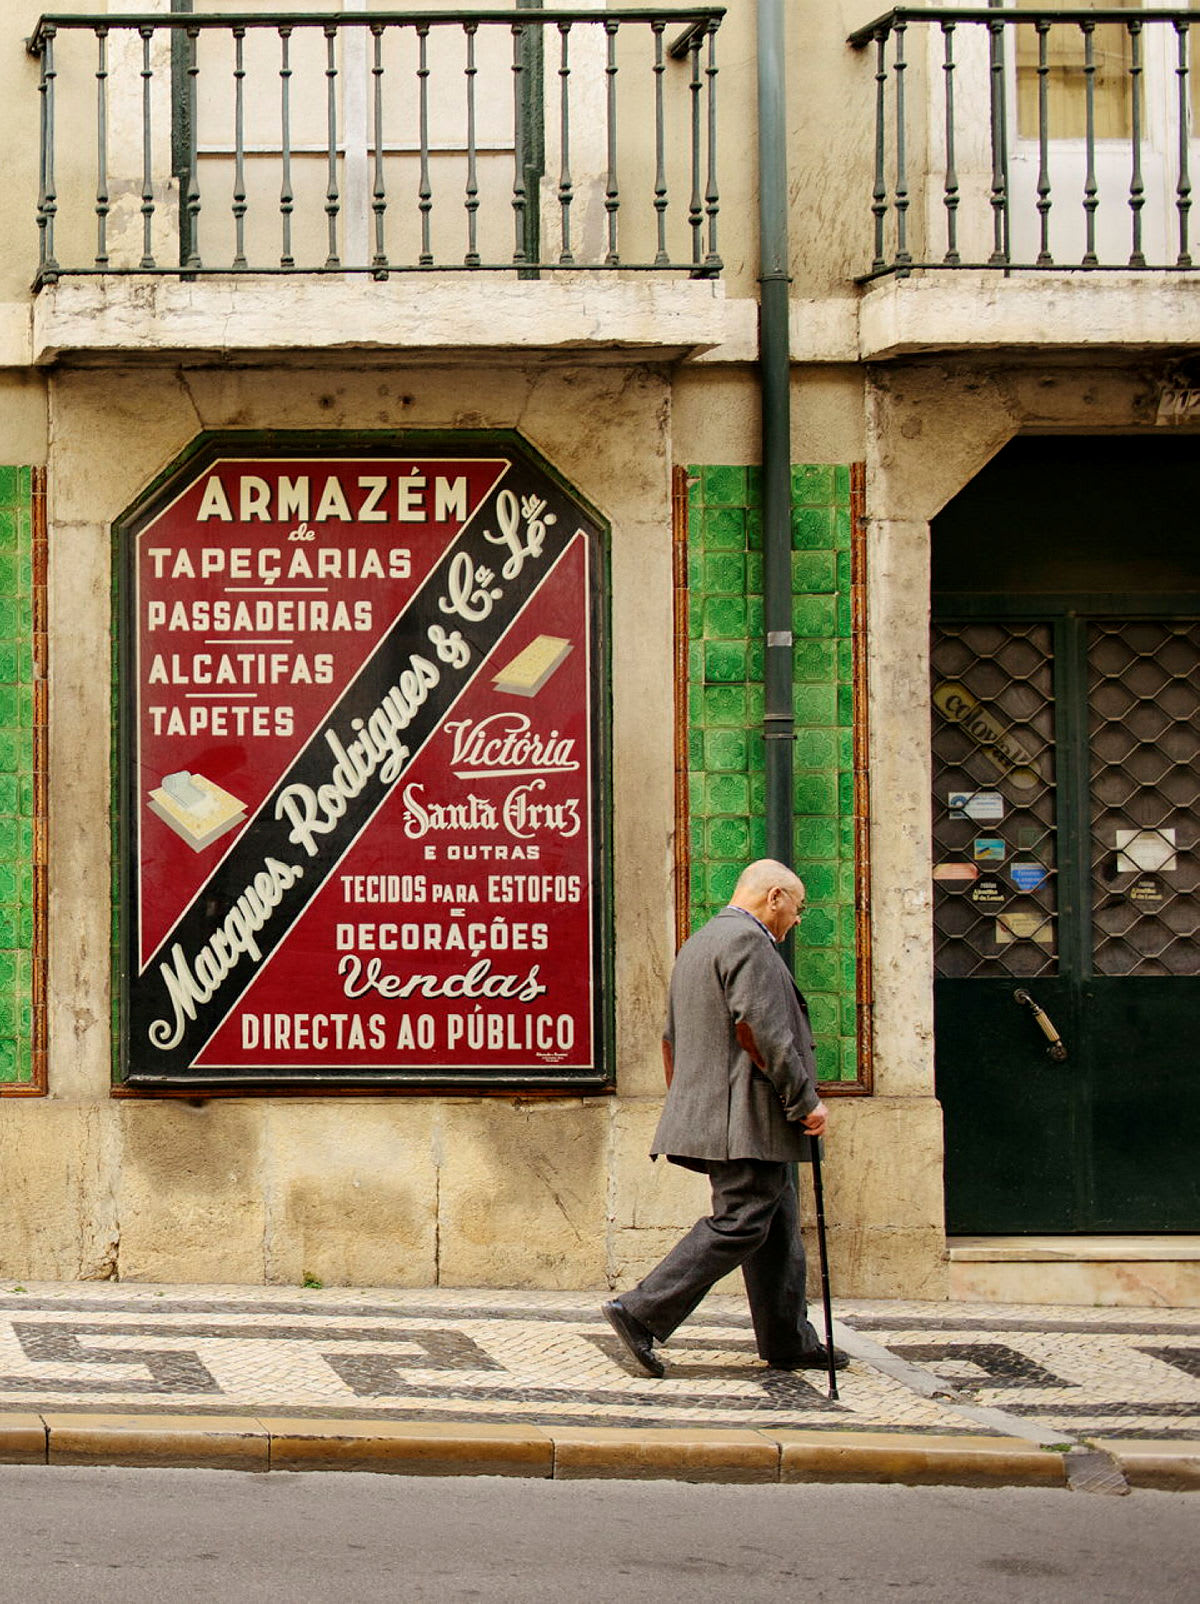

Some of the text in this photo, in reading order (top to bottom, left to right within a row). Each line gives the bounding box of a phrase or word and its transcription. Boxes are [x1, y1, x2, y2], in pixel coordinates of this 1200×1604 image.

[196, 466, 468, 523] ARMAZÉM
[288, 523, 315, 541] de
[148, 548, 411, 585] TAPEÇARIAS
[148, 601, 373, 632] PASSADEIRAS
[148, 654, 334, 684] ALCATIFAS
[148, 706, 294, 736] TAPETES
[275, 654, 440, 857] Rodrigues
[427, 625, 472, 670] &
[444, 712, 580, 771] Victória
[403, 779, 581, 839] Santa Cruz
[424, 845, 541, 860] E OUTRAS
[341, 875, 581, 903] TECIDOS PARA ESTOFOS
[450, 908, 465, 917] E
[336, 916, 549, 957] DECORAÇÕES
[338, 954, 547, 1001] Vendas
[242, 1004, 575, 1050] DIRECTAS AO PÚBLICO
